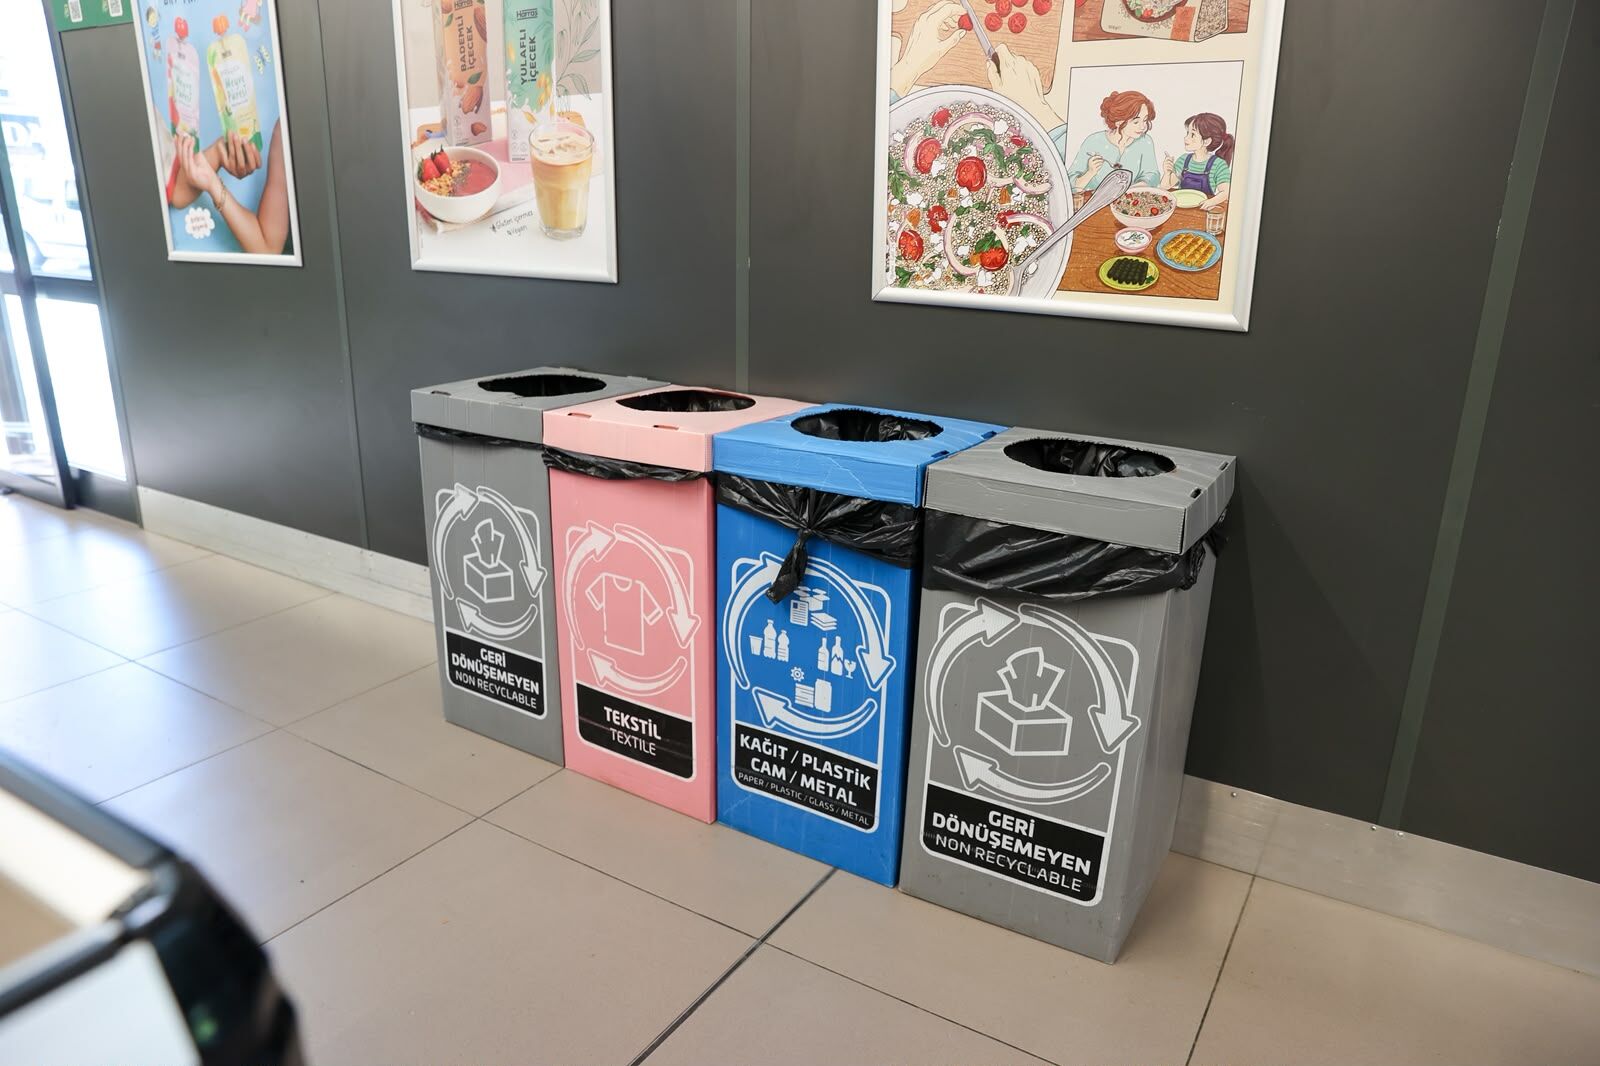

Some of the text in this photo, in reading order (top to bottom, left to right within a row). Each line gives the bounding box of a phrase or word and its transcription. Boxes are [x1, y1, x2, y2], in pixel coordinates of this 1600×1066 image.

[517, 8, 538, 20] Harras
[455, 15, 466, 72] BADEMLİ
[466, 25, 476, 70] İÇECEK
[519, 29, 527, 85] YULAFLI
[528, 36, 538, 82] İÇECEK
[451, 653, 539, 695] DÖNÜŞEMEYEN
[480, 648, 506, 666] GERİ
[455, 670, 537, 709] NON RECYCLABLE
[604, 706, 661, 740] TEKSTİL
[609, 727, 656, 756] TEXTILE
[740, 733, 871, 791] KAĞIT / PLASTİK
[751, 757, 858, 806] CAM / METAL
[738, 772, 764, 786] PAPER
[770, 783, 802, 801] PLASTIC
[809, 796, 834, 812] GLASS
[841, 808, 870, 826] METAL
[932, 811, 1091, 876] DÖNÜŞEMEYEN
[988, 810, 1035, 838] GERİ
[935, 833, 1082, 893] NON RECYCLABLE
